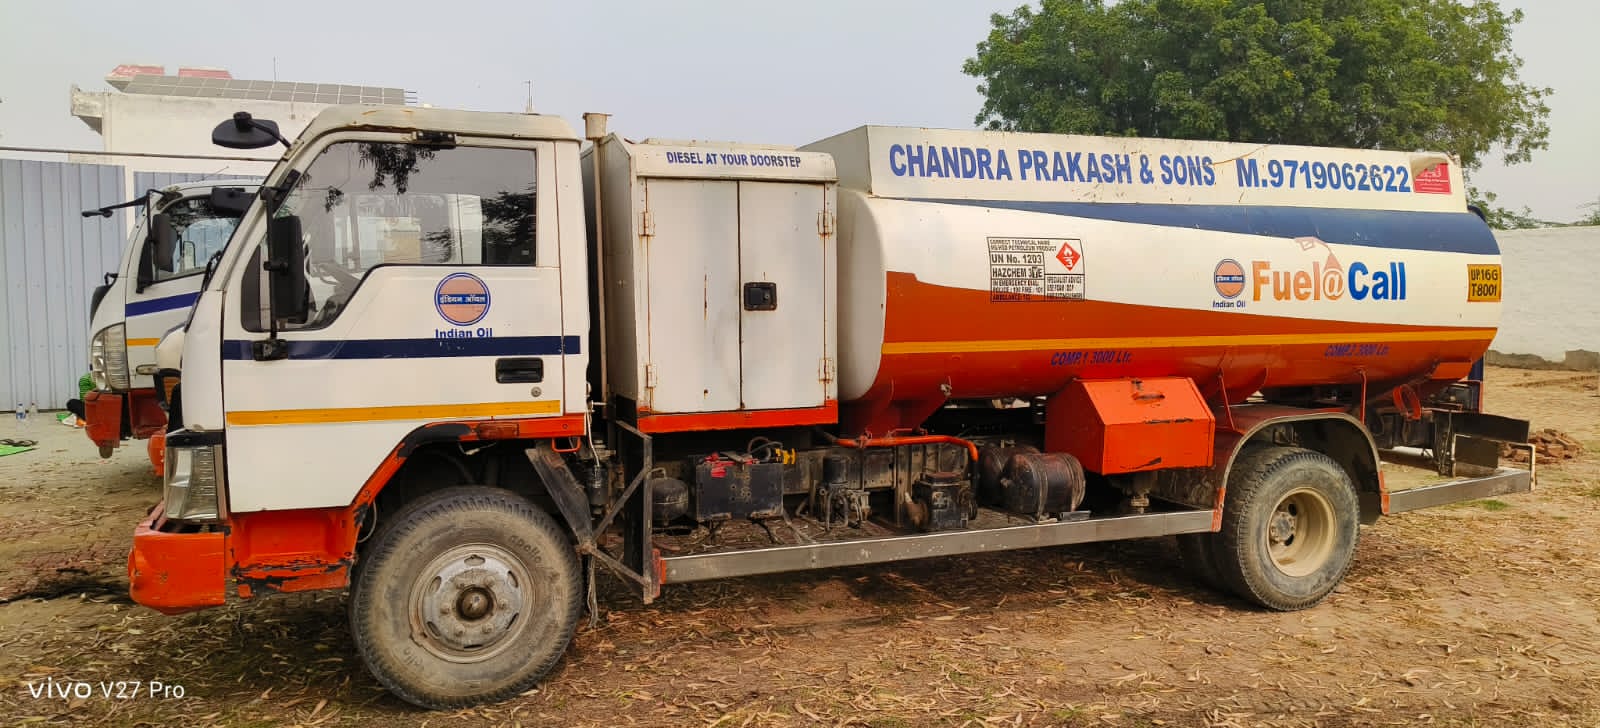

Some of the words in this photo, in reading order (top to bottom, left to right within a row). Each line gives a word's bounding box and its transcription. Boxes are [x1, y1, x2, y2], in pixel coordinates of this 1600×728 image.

[666, 152, 703, 164] DIESEL
[706, 153, 718, 165] AT
[720, 153, 749, 166] YOUR
[750, 154, 801, 167] DOORSTEP
[889, 144, 1013, 180] CHANDRA
[1018, 149, 1133, 184] PRAKASH
[1139, 154, 1155, 184] &
[1159, 154, 1216, 186] SONS
[1235, 158, 1411, 192] M.9719062622
[991, 254, 1004, 263] UN
[1006, 254, 1020, 263] No.
[1023, 254, 1042, 264] 1203
[992, 267, 1026, 278] HAZCHEM
[1212, 300, 1235, 308] Indian
[1236, 300, 1245, 308] Oil
[435, 328, 473, 338] Indian
[476, 327, 493, 338] Oil
